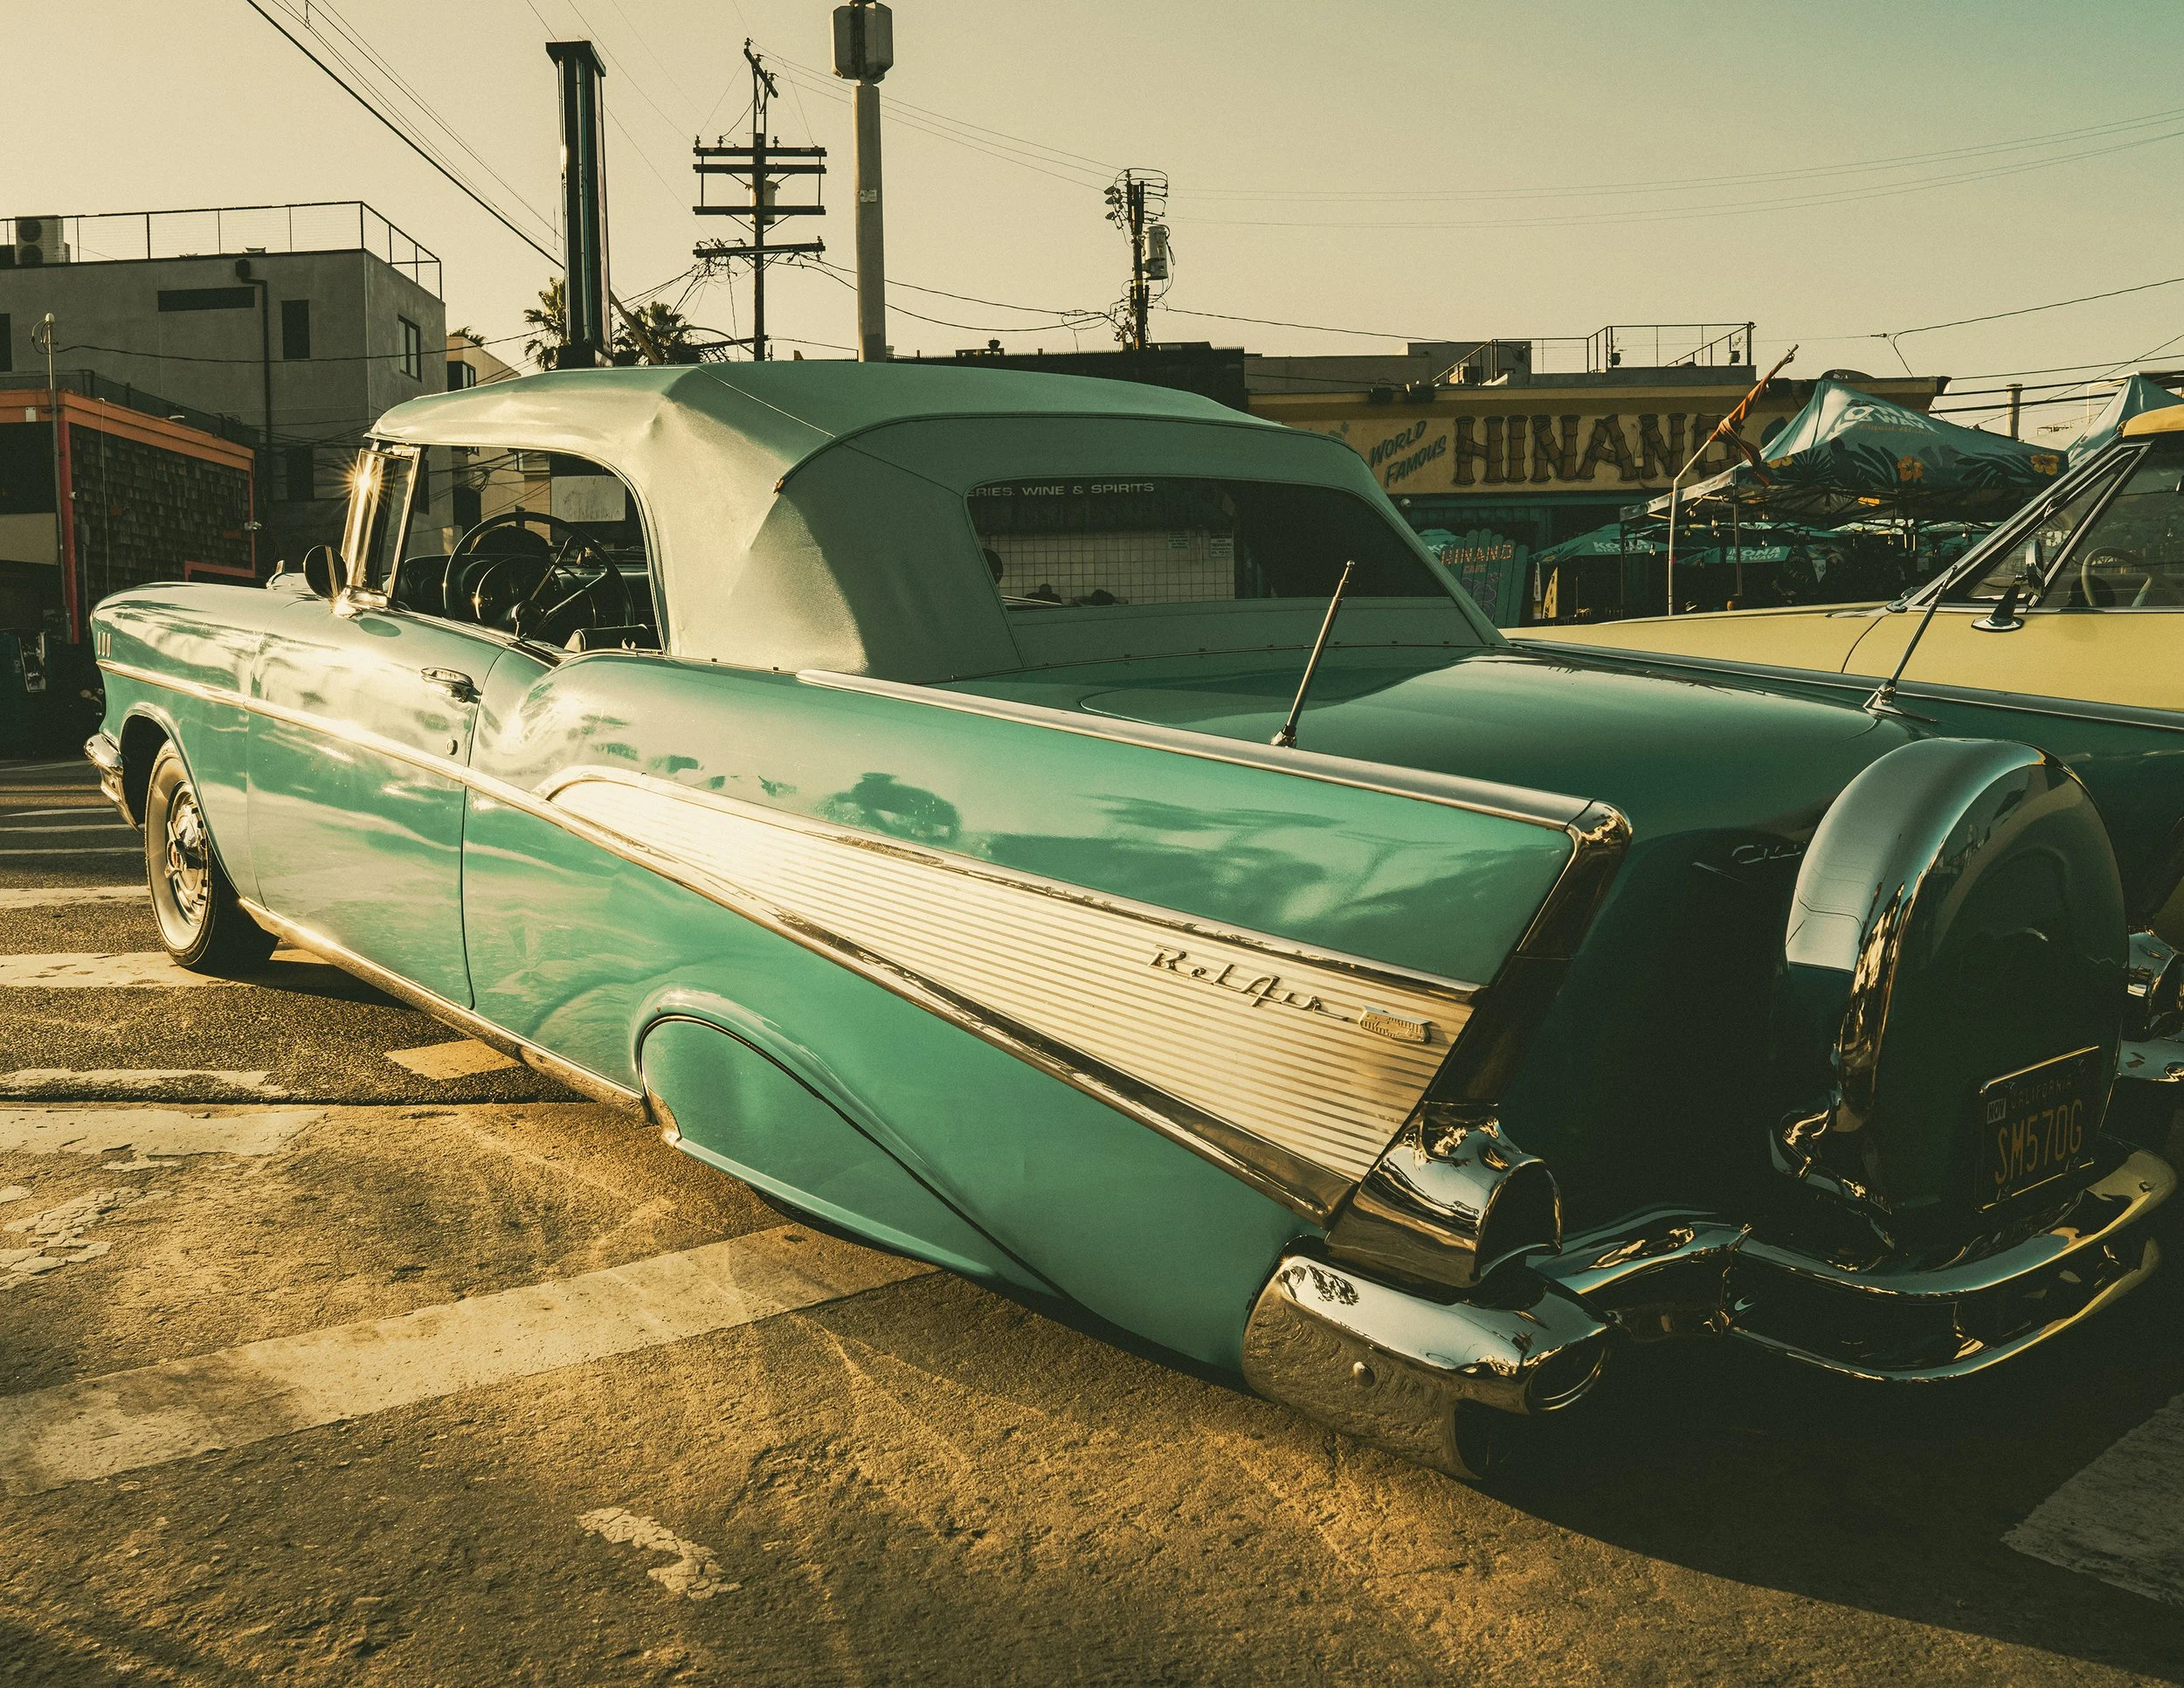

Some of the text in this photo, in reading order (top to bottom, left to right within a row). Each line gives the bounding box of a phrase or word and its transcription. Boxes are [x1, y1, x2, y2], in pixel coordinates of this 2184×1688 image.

[1370, 419, 1427, 467] WORLD
[1384, 434, 1448, 488] FAMOUS
[1453, 413, 1743, 486] HINANO
[1021, 486, 1065, 496] WINE
[1072, 485, 1084, 495] &
[1090, 482, 1155, 494] SPIRITS
[1147, 944, 1351, 1022] Bel Air
[1987, 1098, 2006, 1124] NOV
[2011, 1074, 2073, 1110] CALIFORNIA
